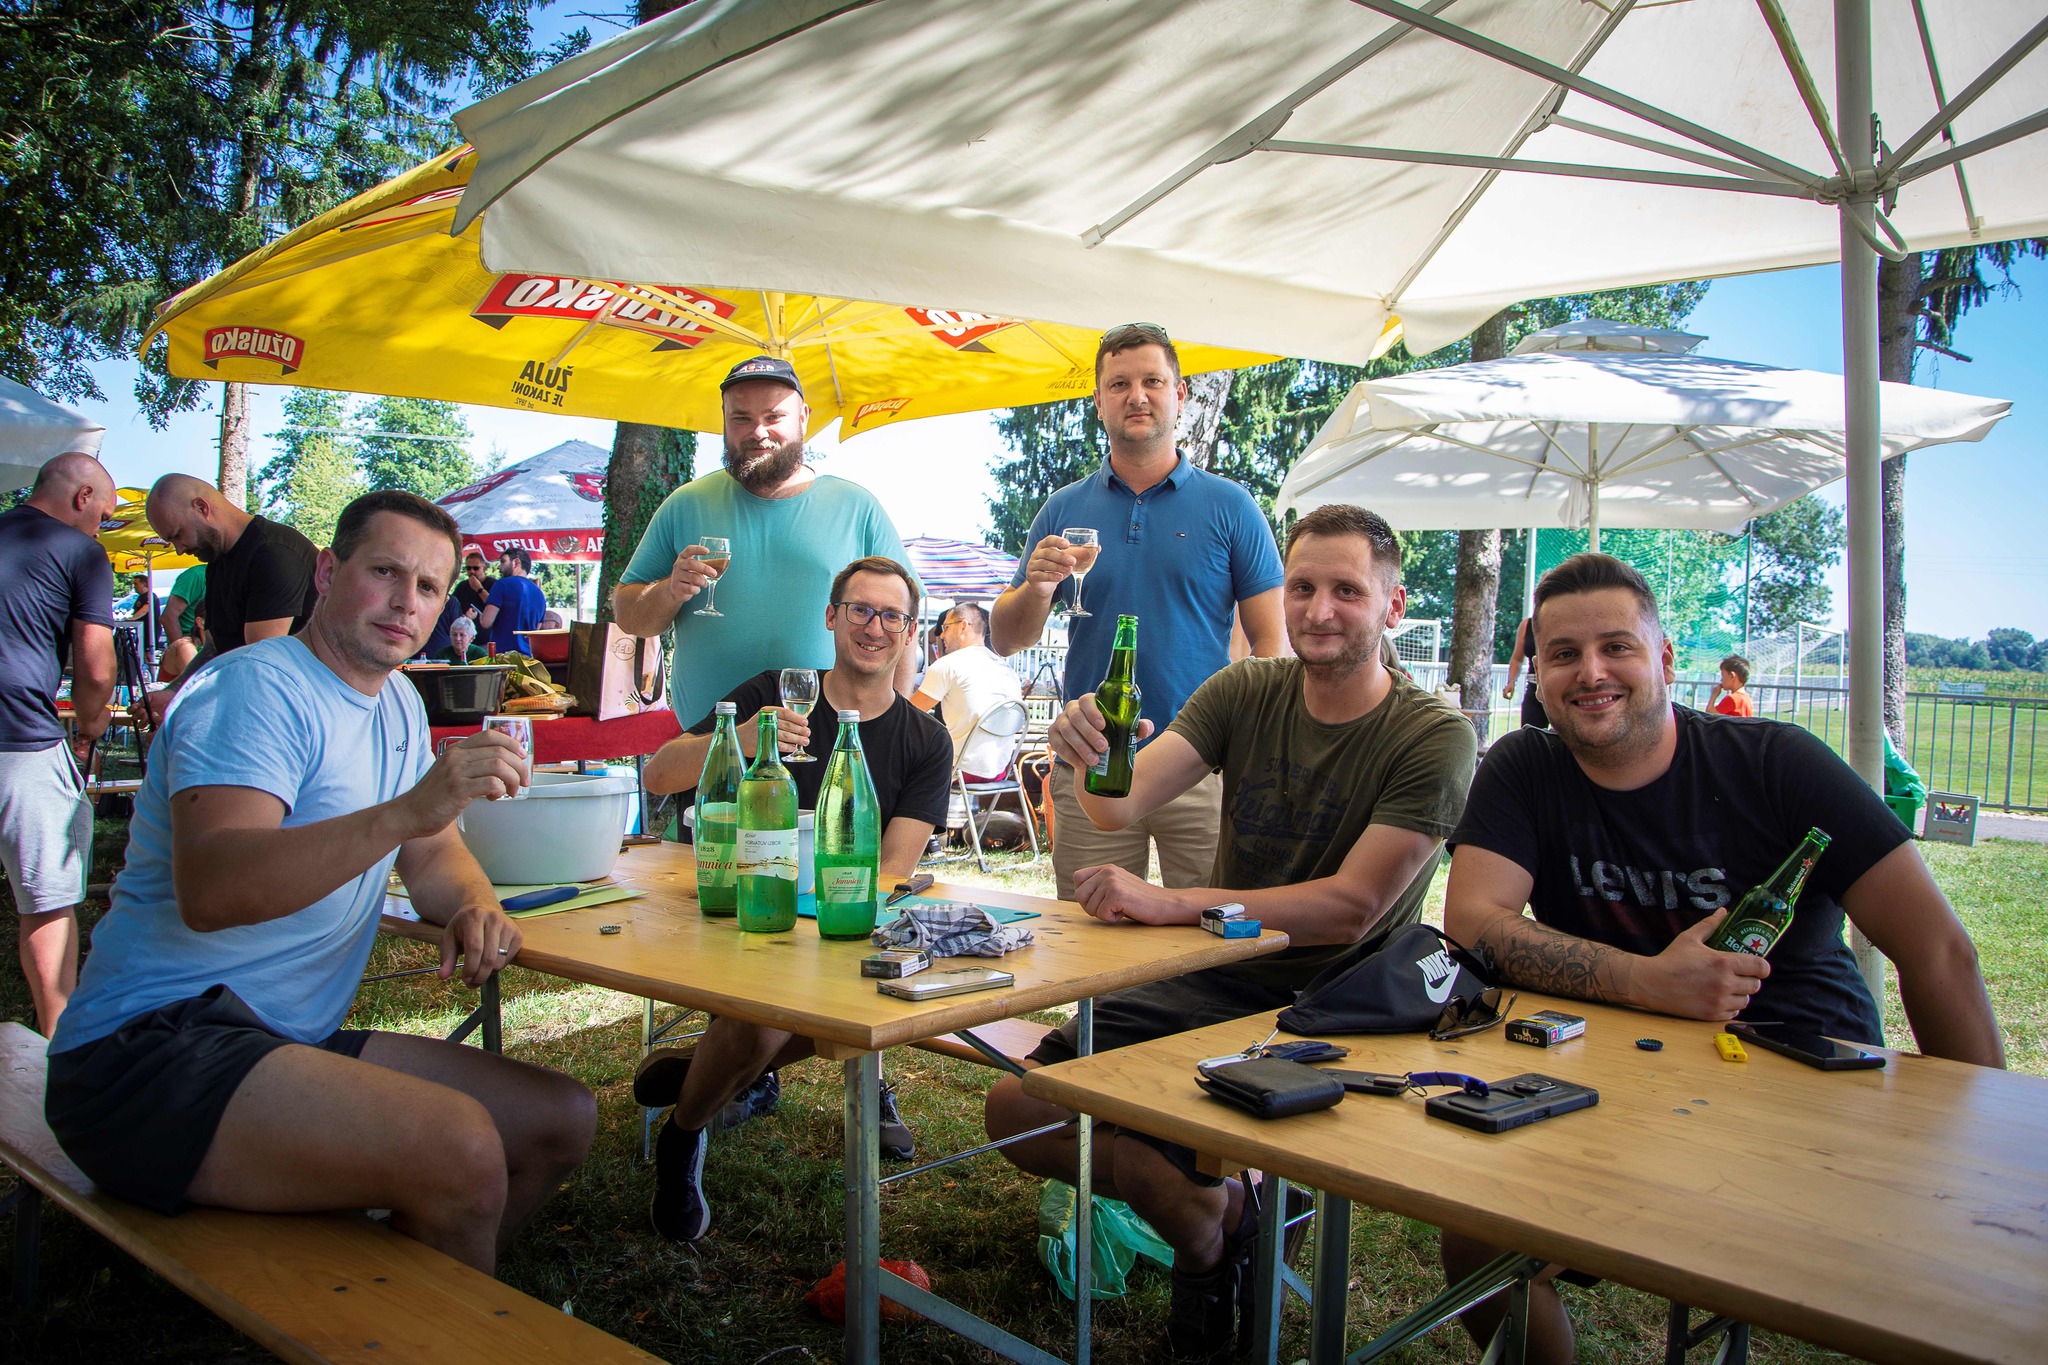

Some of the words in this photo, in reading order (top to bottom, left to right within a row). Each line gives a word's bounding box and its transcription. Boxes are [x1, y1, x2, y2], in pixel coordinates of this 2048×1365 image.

[493, 538, 551, 552] STELLA
[1415, 949, 1455, 983] NIKE
[1513, 1033, 1540, 1044] CAMEL
